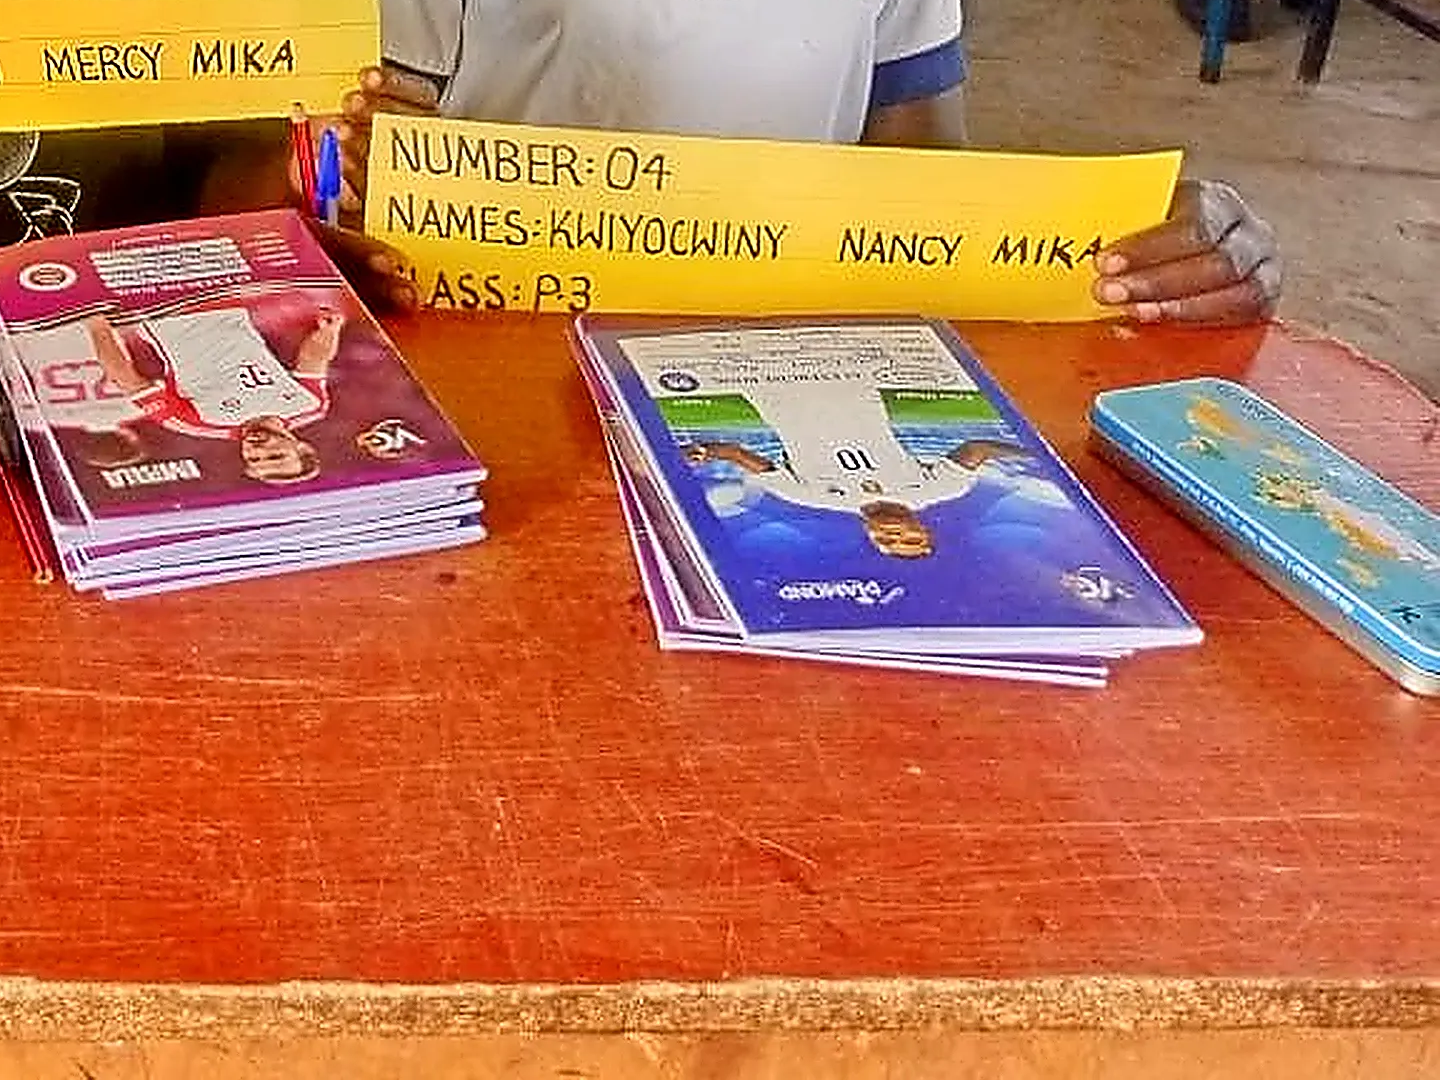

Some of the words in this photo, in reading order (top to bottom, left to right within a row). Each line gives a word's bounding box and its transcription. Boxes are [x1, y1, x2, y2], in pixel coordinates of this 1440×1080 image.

[45, 43, 161, 81] MERCY
[194, 40, 293, 73] MIKA
[840, 229, 961, 265] NANCY
[993, 237, 1100, 269] MIKA
[834, 446, 879, 474] 10
